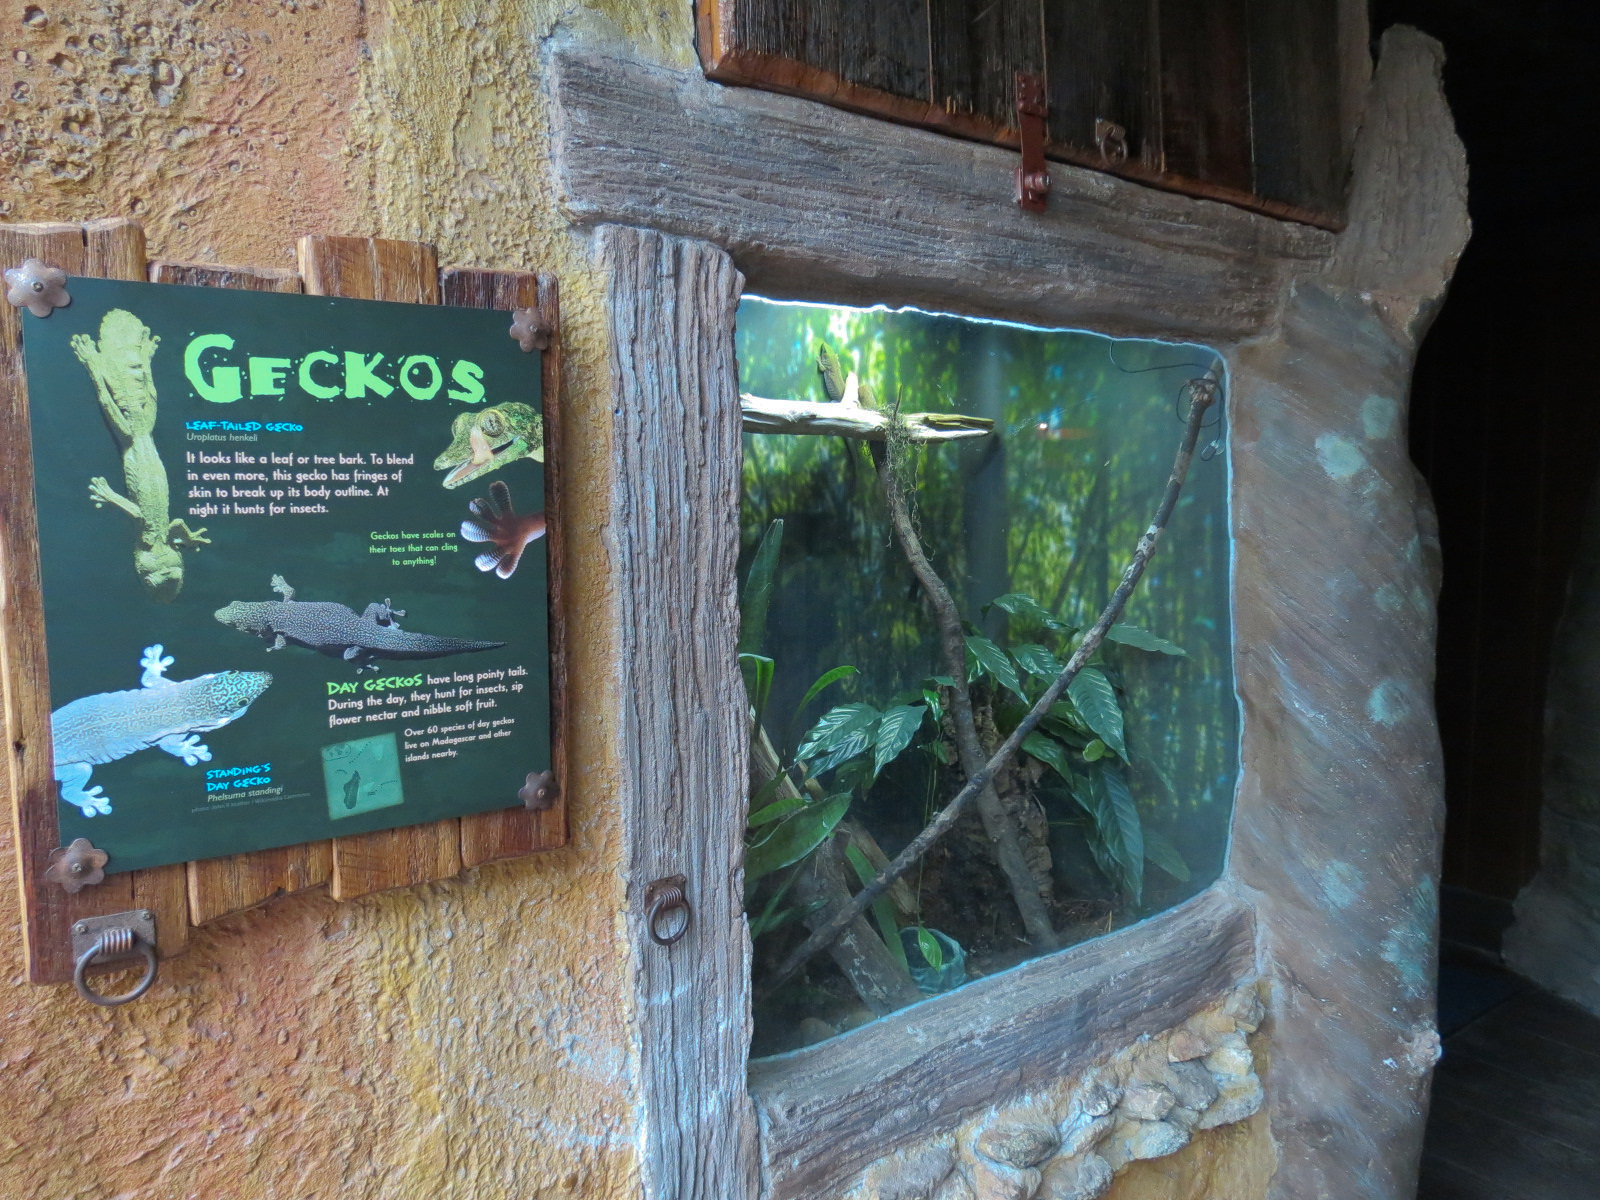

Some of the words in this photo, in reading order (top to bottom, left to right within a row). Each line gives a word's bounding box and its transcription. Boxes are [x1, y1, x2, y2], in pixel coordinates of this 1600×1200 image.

[265, 422, 304, 432] GECKO
[186, 433, 227, 443] Uroplatus
[229, 433, 258, 442] henkeli
[186, 451, 196, 464] It
[200, 451, 231, 464] looks
[235, 452, 255, 464] like
[260, 455, 267, 464] a
[271, 452, 294, 466] leaf
[297, 455, 309, 465] or
[314, 454, 335, 464] tree
[339, 453, 366, 465] bark.
[370, 453, 383, 465] To
[387, 453, 414, 465] blend
[187, 470, 198, 480] in
[202, 472, 230, 481] even
[235, 472, 268, 482] more,
[273, 470, 292, 481] this
[296, 470, 328, 483] gecko
[331, 470, 350, 481] has
[354, 469, 388, 483] fringes
[392, 469, 402, 482] of
[188, 486, 212, 498] skin
[216, 487, 228, 498] to
[232, 486, 266, 498] break
[270, 488, 284, 500] up
[288, 486, 300, 497] its
[304, 485, 331, 499] body
[335, 485, 373, 497] outline.
[377, 486, 389, 496] At
[189, 503, 218, 517] night
[222, 503, 230, 514] it
[234, 503, 265, 514] hunts
[269, 502, 285, 516] for
[290, 503, 329, 514] insects.
[370, 531, 399, 540] Geckos
[401, 530, 420, 539] have
[422, 530, 444, 538] scales
[369, 545, 387, 553] their
[408, 543, 423, 552] that
[441, 542, 457, 552] cling
[402, 556, 437, 567] anything!
[327, 682, 359, 695] DAY
[364, 674, 422, 691] GECKOS
[427, 674, 450, 685] have
[454, 671, 474, 683] long
[477, 670, 505, 683] pointy
[508, 665, 528, 677] tails.
[328, 699, 363, 711] During
[367, 697, 383, 706] the
[386, 693, 407, 706] day,
[411, 690, 431, 703] they
[434, 688, 455, 700] hunt
[459, 686, 472, 698] for
[476, 684, 508, 694] insects,
[511, 682, 524, 693] sip
[329, 715, 362, 728] flower
[366, 711, 397, 722] nectar
[402, 706, 420, 718] and
[423, 703, 452, 715] nibble
[455, 700, 472, 712] soft
[476, 698, 498, 710] fruit.
[404, 728, 425, 737] Over
[427, 726, 438, 734] 60
[441, 723, 465, 734] species
[468, 721, 475, 730] of
[477, 719, 490, 729] day
[492, 716, 515, 727] geckos
[404, 741, 418, 750] live
[432, 734, 476, 746] Madagascar
[479, 730, 491, 740] and
[494, 729, 511, 738] other
[405, 753, 430, 763] islands
[432, 749, 458, 760] nearby.
[206, 763, 271, 780] STANDING'S
[207, 782, 229, 791] DAY
[233, 777, 271, 788] GECKO
[208, 792, 245, 802] Phelsuma
[248, 785, 283, 796] standingi
